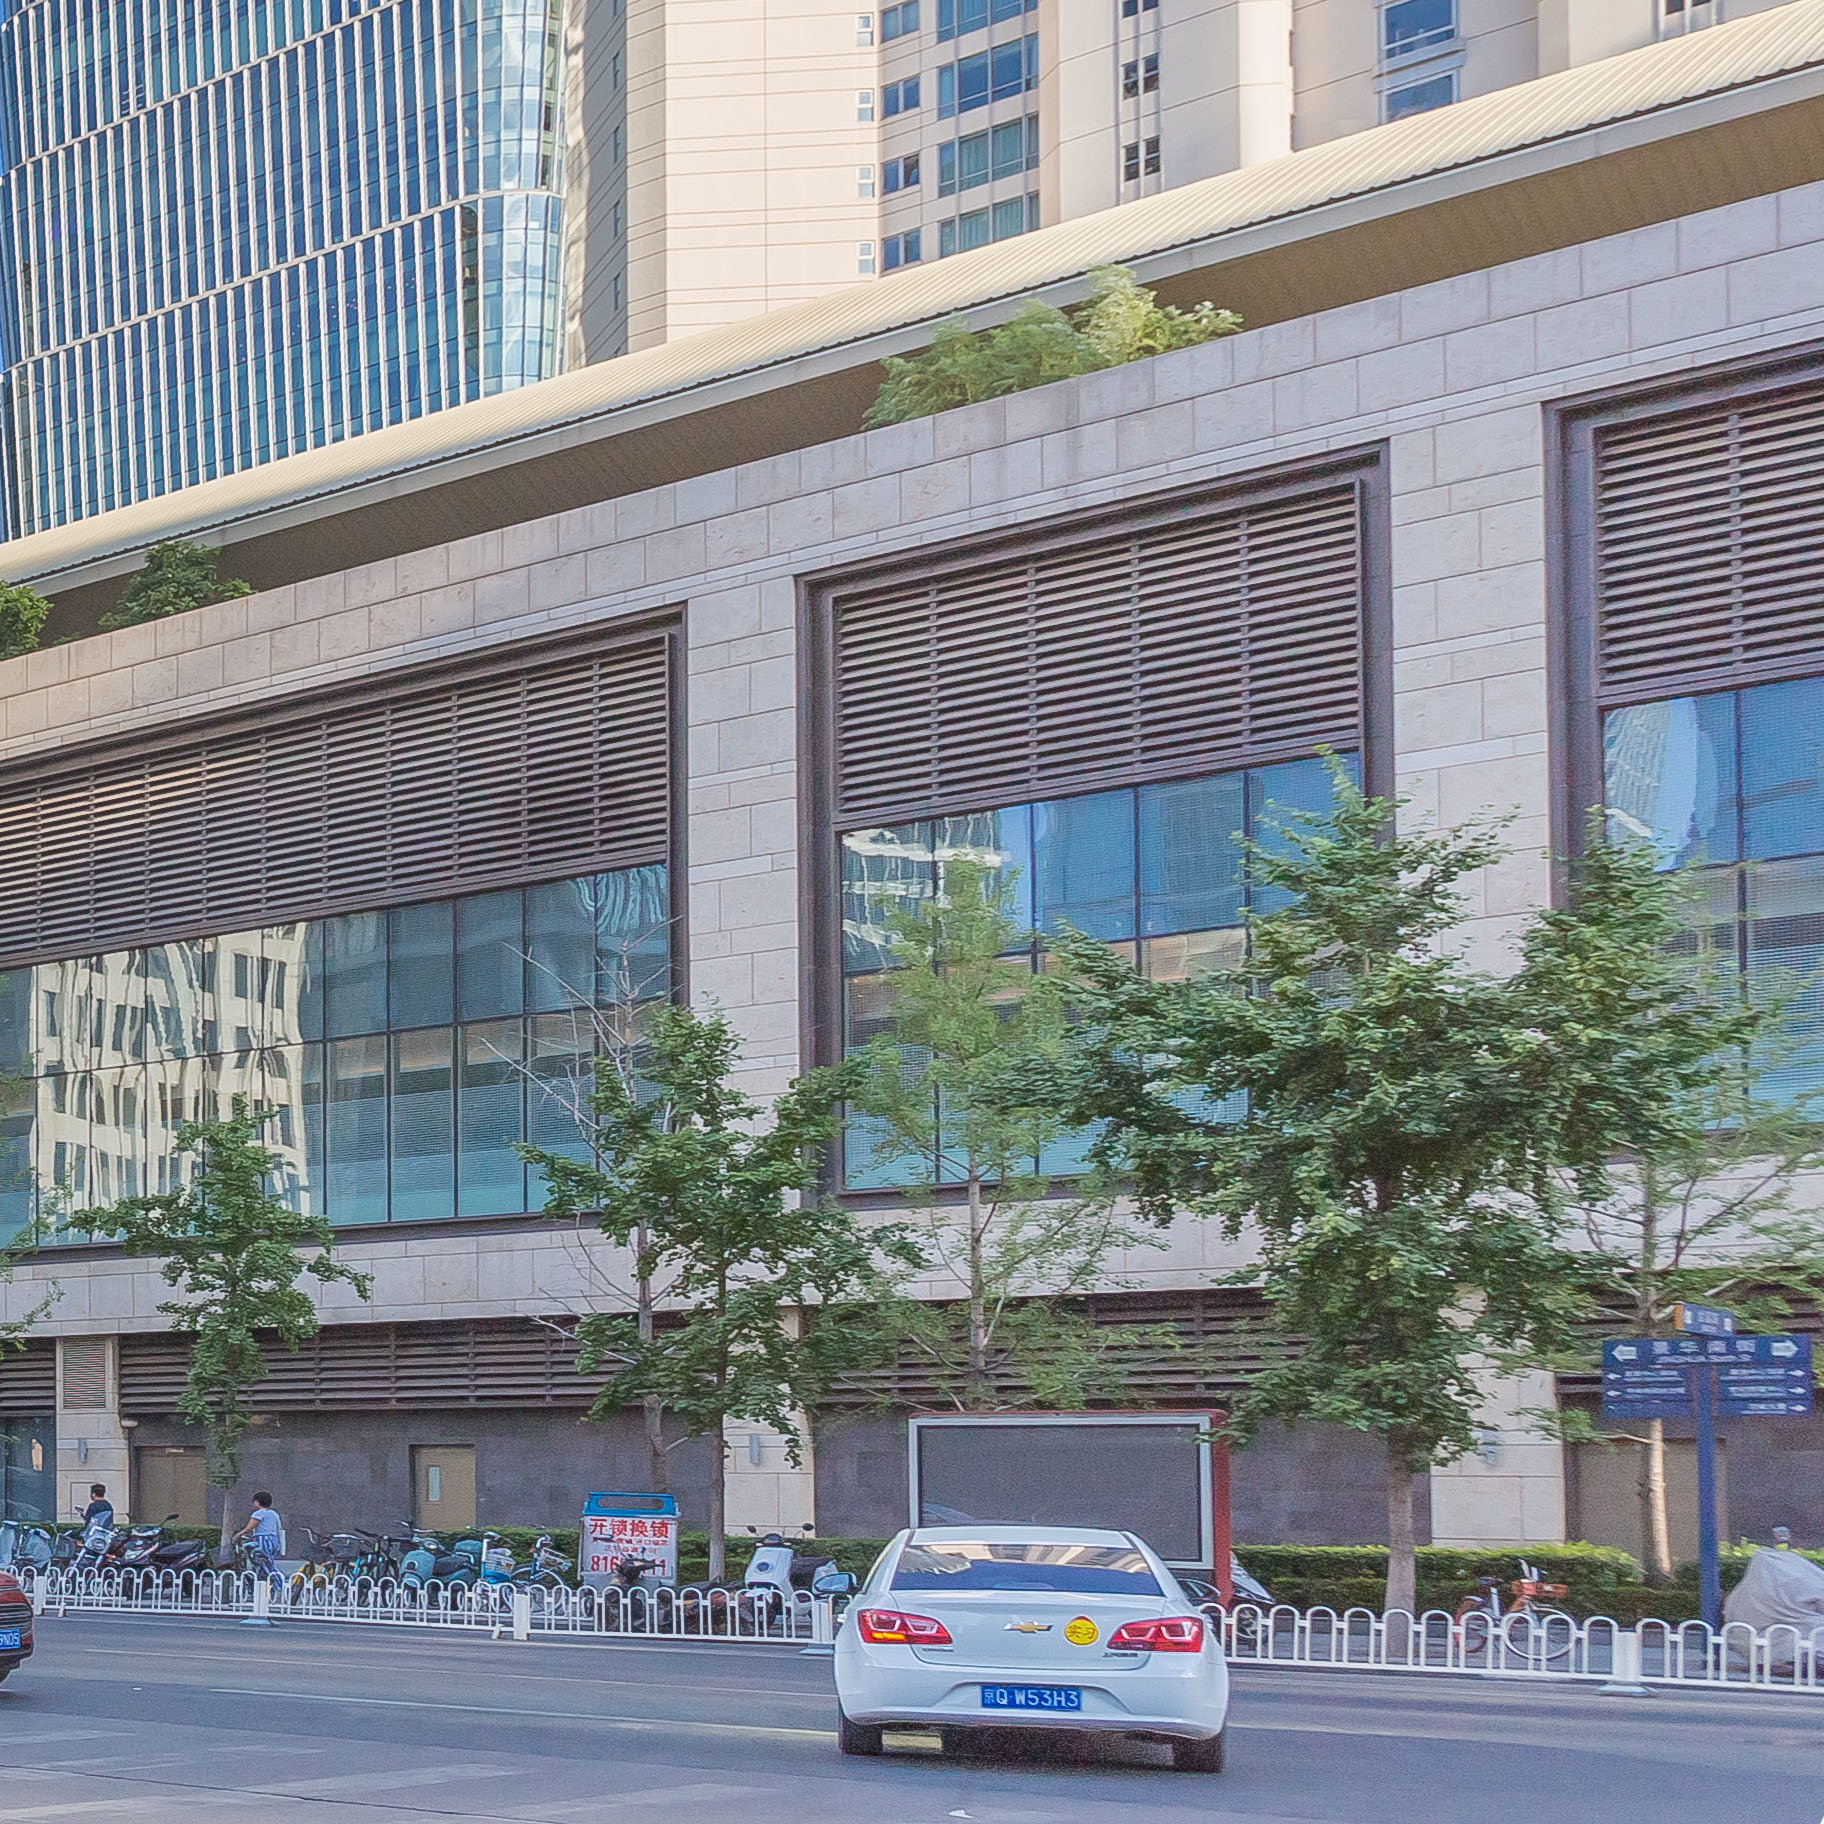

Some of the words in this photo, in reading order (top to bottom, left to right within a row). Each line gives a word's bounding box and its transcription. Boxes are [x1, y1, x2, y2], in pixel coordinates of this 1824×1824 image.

[589, 1518, 669, 1538] 开锁换锁
[1067, 1624, 1096, 1640] 实习
